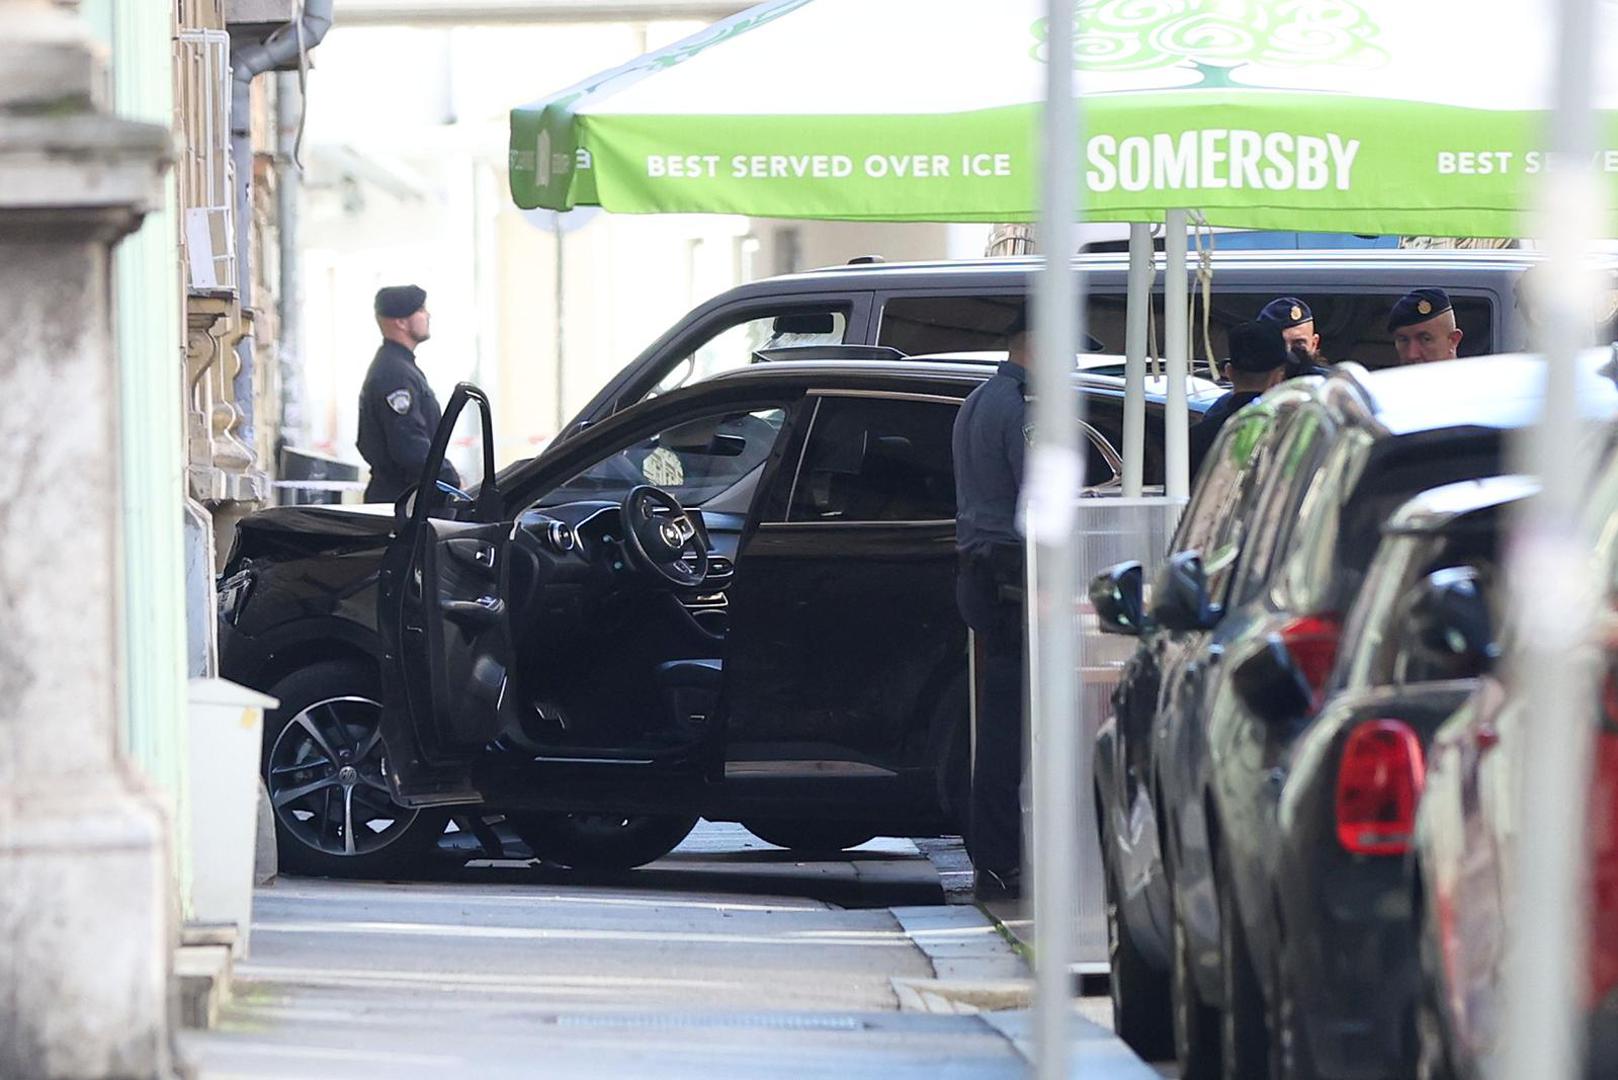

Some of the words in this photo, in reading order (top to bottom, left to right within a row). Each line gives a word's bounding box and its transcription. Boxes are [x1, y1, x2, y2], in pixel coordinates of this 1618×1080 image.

[647, 155, 720, 177] BEST
[732, 154, 852, 178] SERVED
[864, 154, 949, 178] OVER
[962, 153, 1011, 176] ICE
[1086, 129, 1360, 192] SOMERSBY
[1438, 151, 1513, 174] BEST
